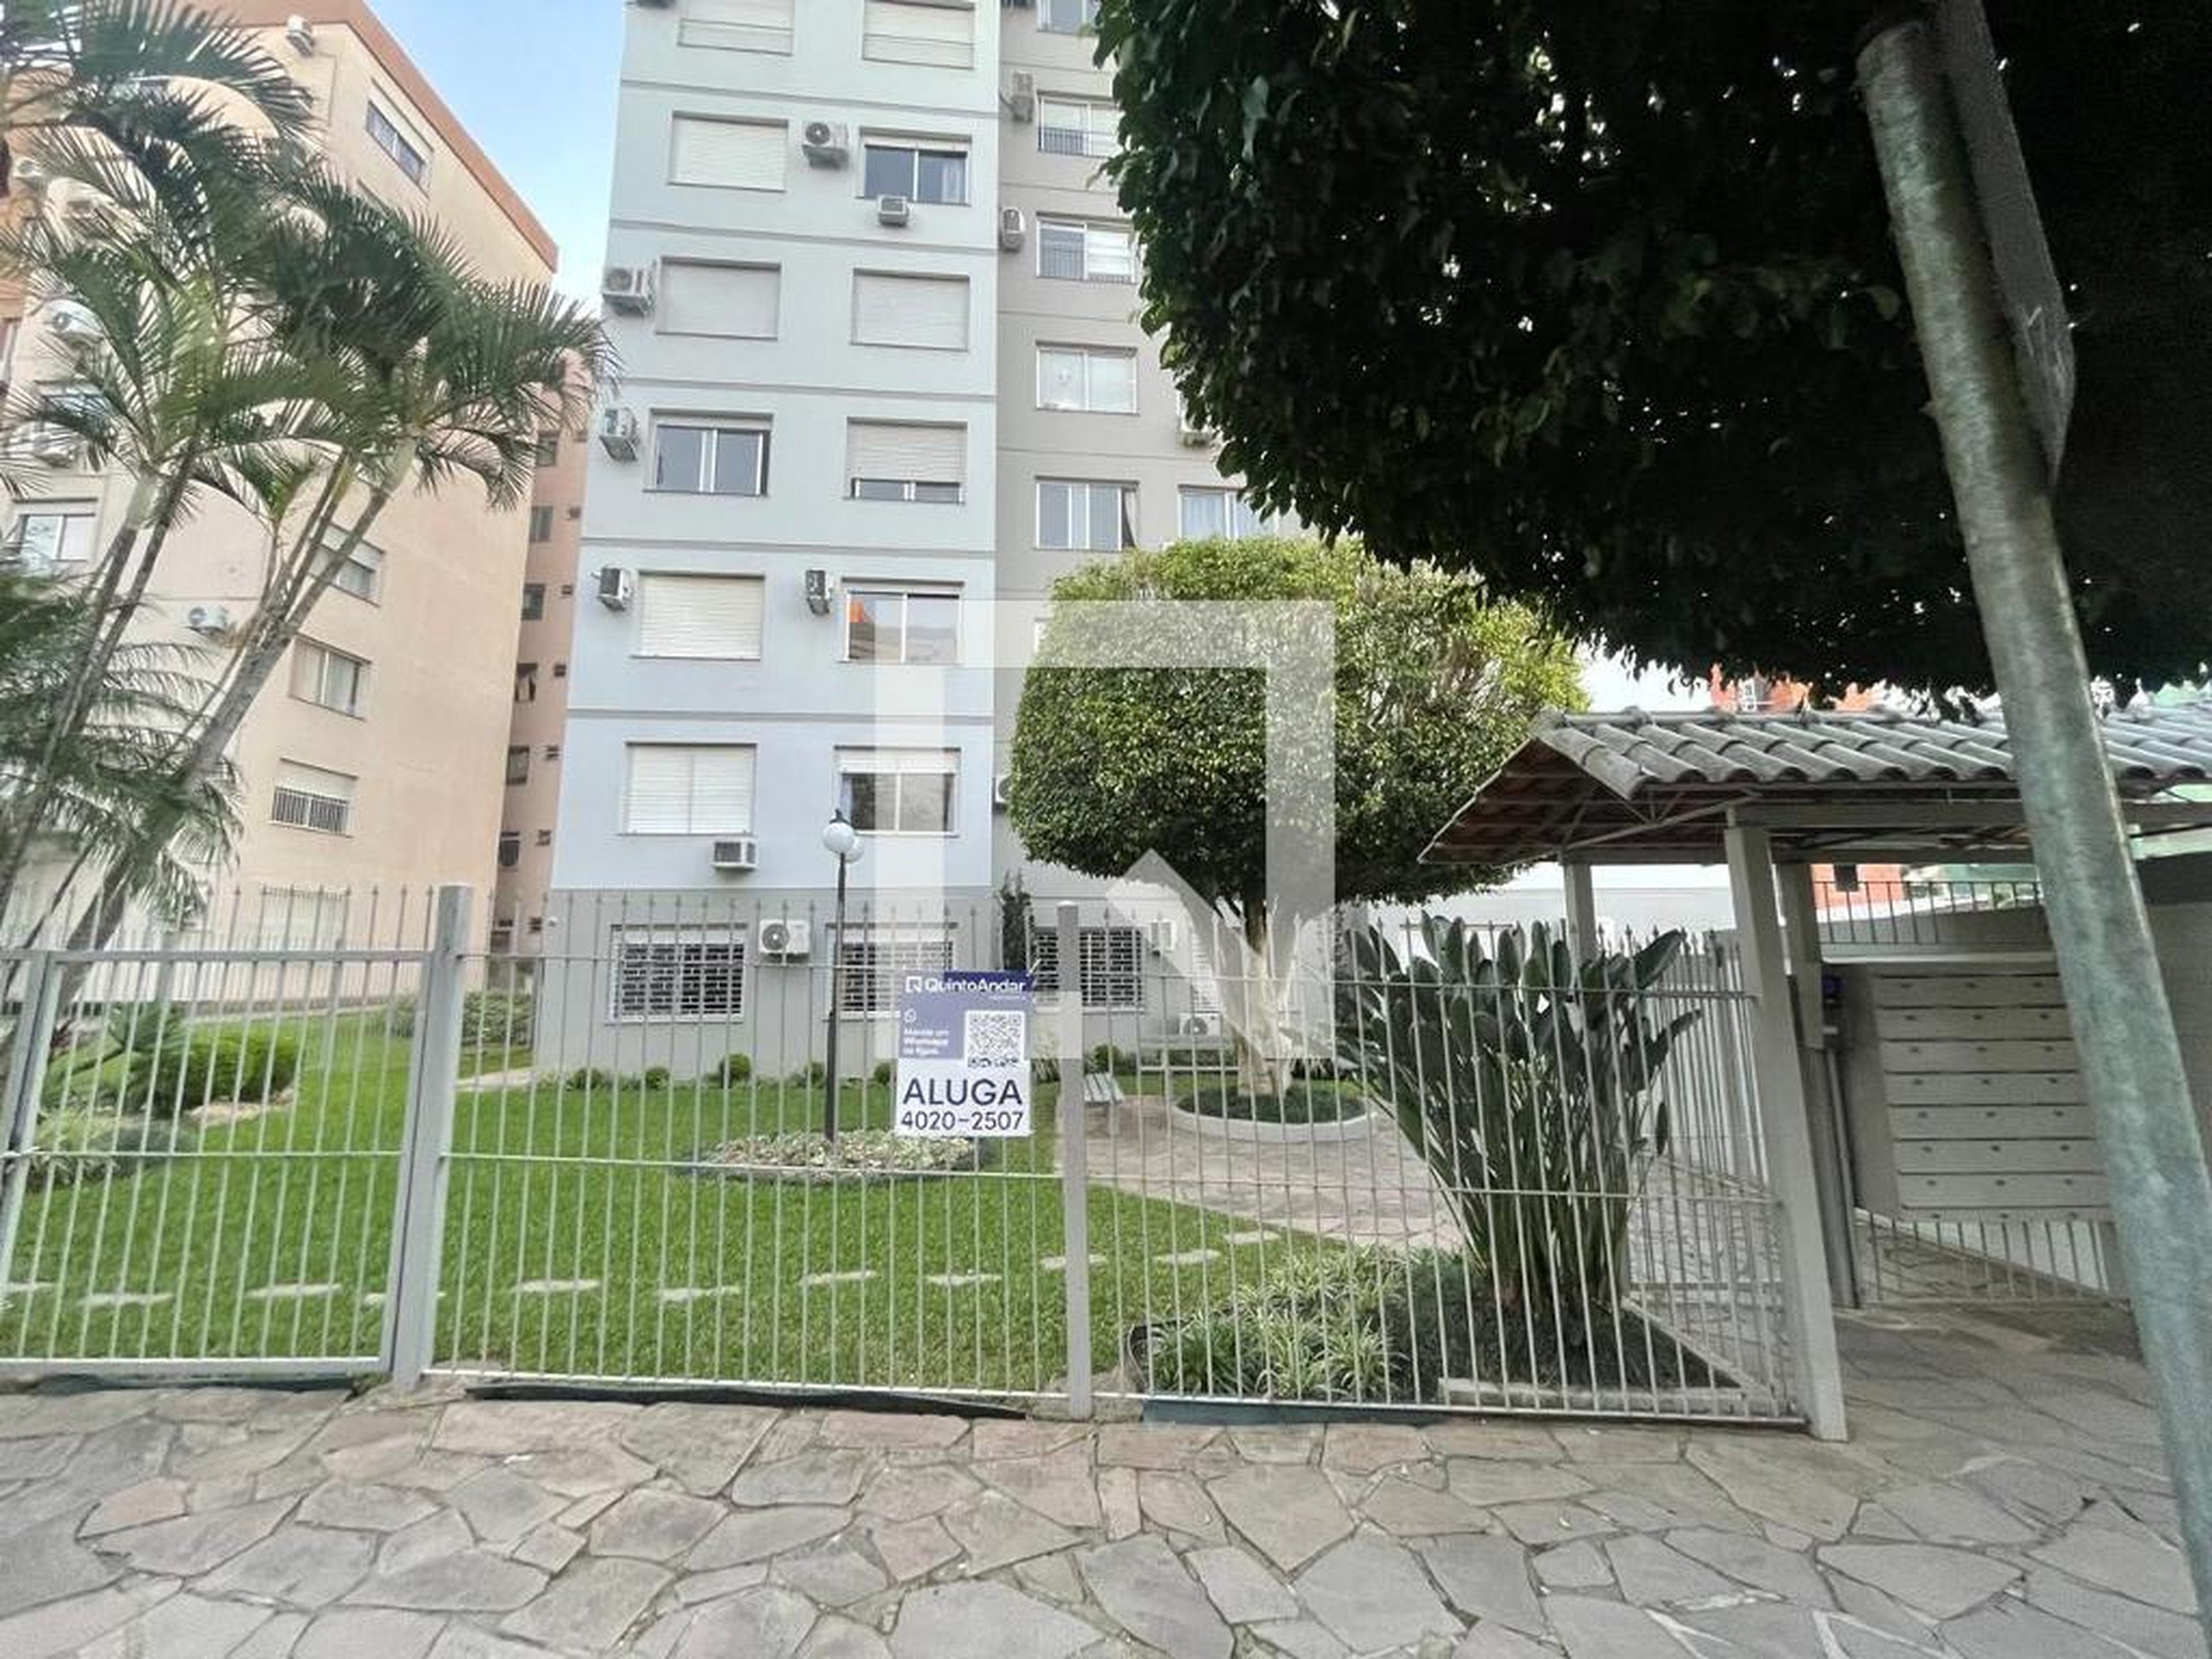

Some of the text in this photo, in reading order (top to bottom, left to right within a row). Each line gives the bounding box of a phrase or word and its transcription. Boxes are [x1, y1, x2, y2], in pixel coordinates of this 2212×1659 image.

[925, 978, 1025, 993] QuintoAndar
[903, 1078, 1022, 1105] ALUGA
[901, 1111, 1023, 1130] 4020-2507
